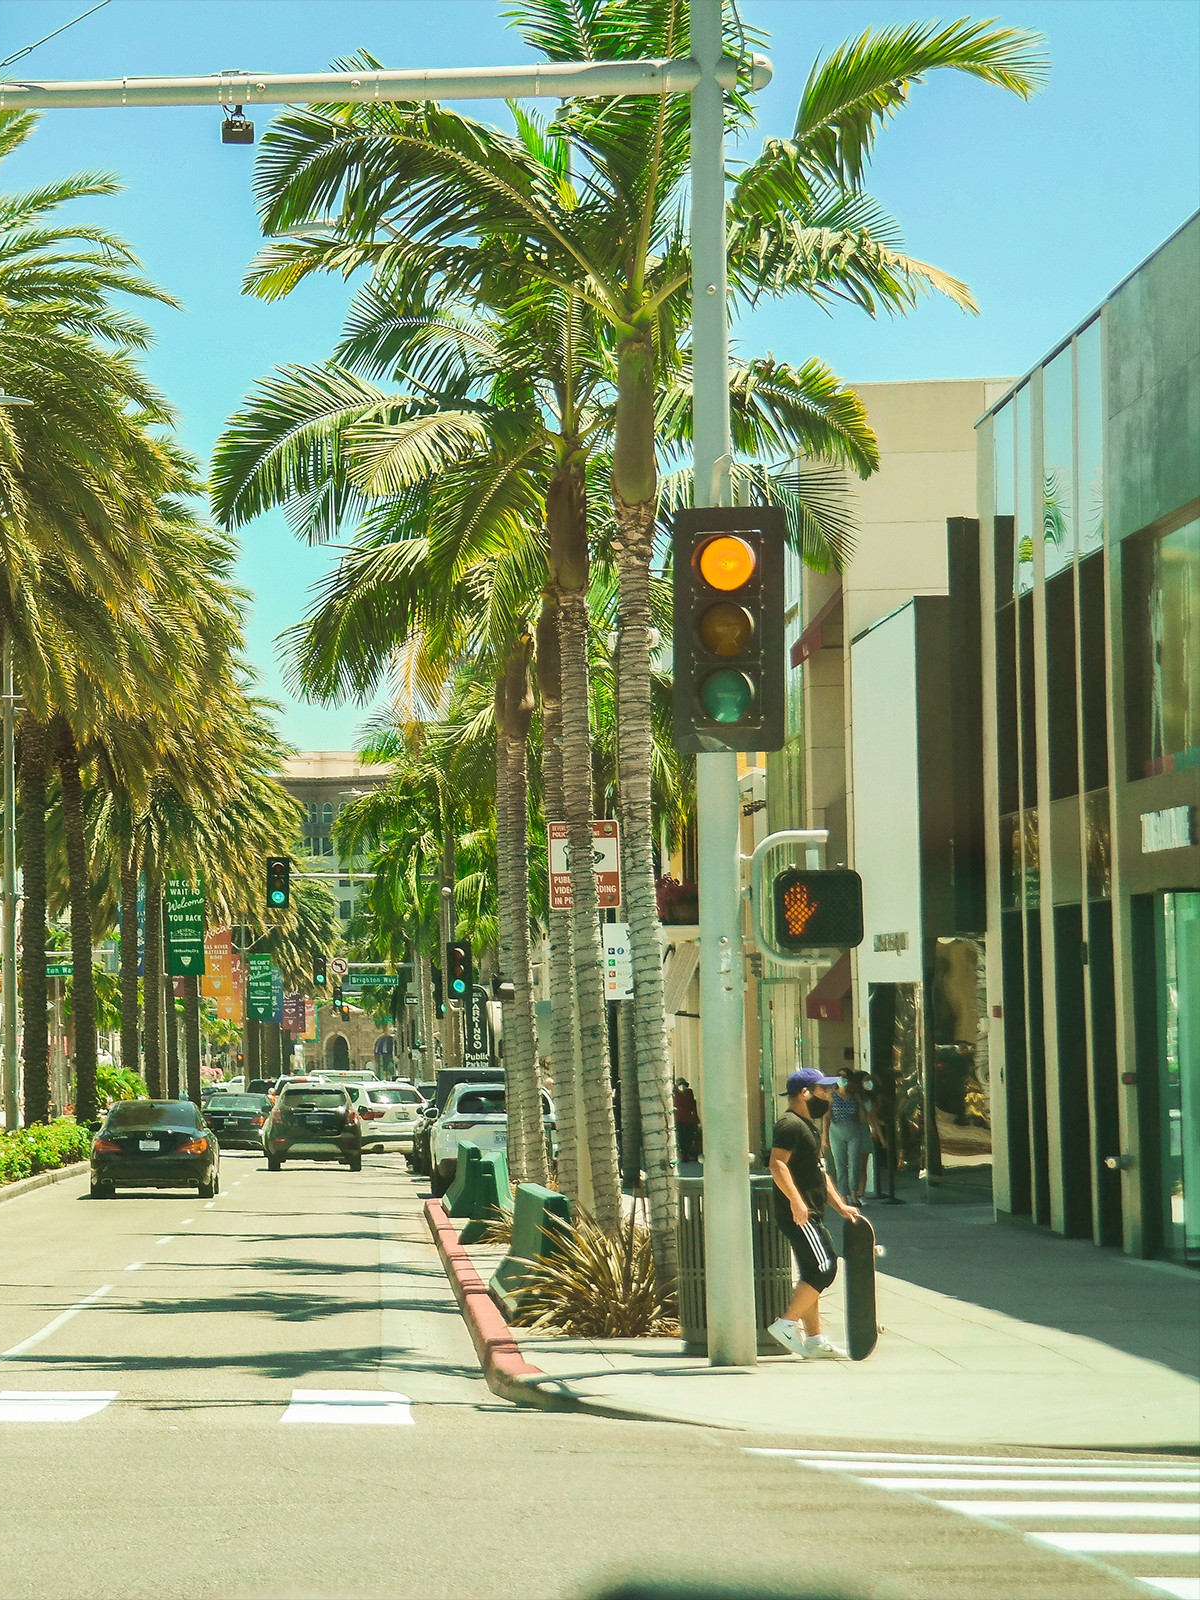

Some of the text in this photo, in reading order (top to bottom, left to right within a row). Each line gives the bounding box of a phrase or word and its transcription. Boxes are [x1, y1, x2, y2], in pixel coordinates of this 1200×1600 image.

[169, 879, 180, 887] WE
[553, 876, 571, 884] PUBL
[170, 888, 201, 896] WAIT TO
[166, 896, 205, 913] Welcome
[554, 897, 563, 905] IN
[168, 914, 202, 922] YOU BACK
[351, 976, 395, 984] Brighton Way
[471, 997, 481, 1040] PARKING
